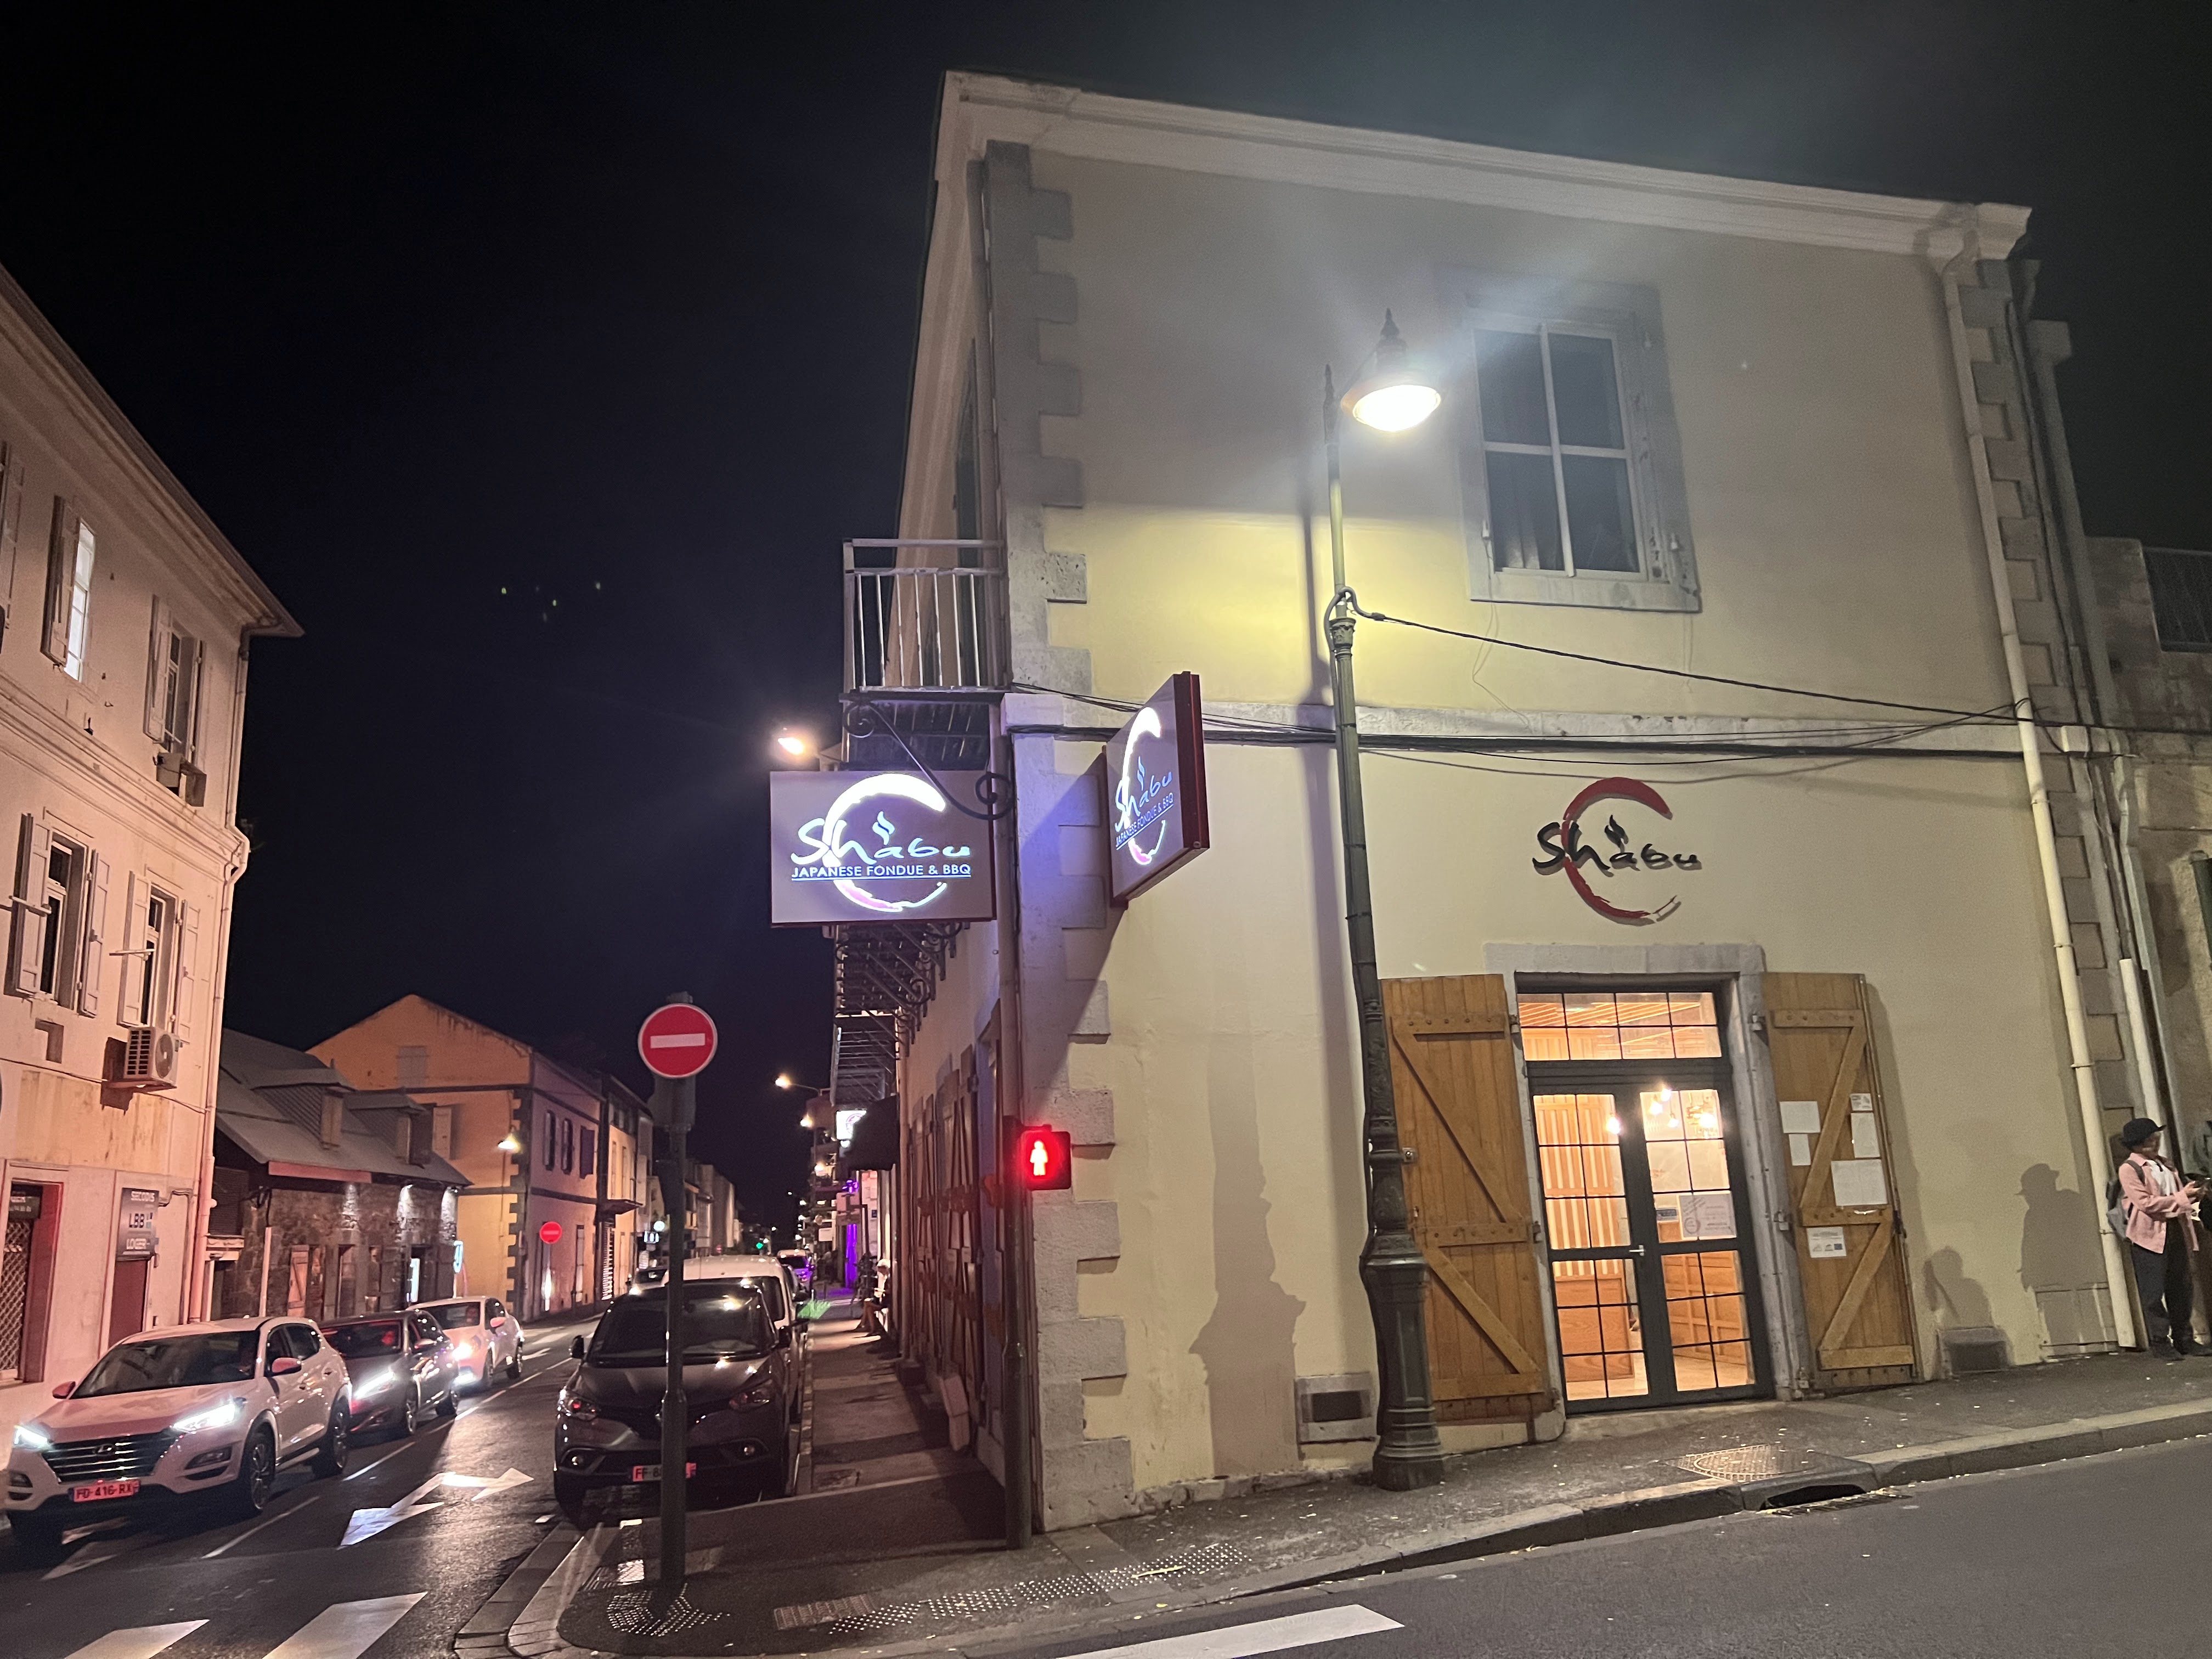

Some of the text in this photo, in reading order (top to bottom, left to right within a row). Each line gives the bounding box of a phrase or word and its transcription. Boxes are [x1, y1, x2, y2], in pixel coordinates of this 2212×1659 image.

[1114, 771, 1173, 832] Shabu
[1115, 792, 1173, 848] JAPANESE FONDUE & BBQ
[791, 817, 971, 865] Shabu
[1532, 821, 1701, 876] Shabu
[792, 864, 972, 878] JAPANESE FONDUE & BBQ
